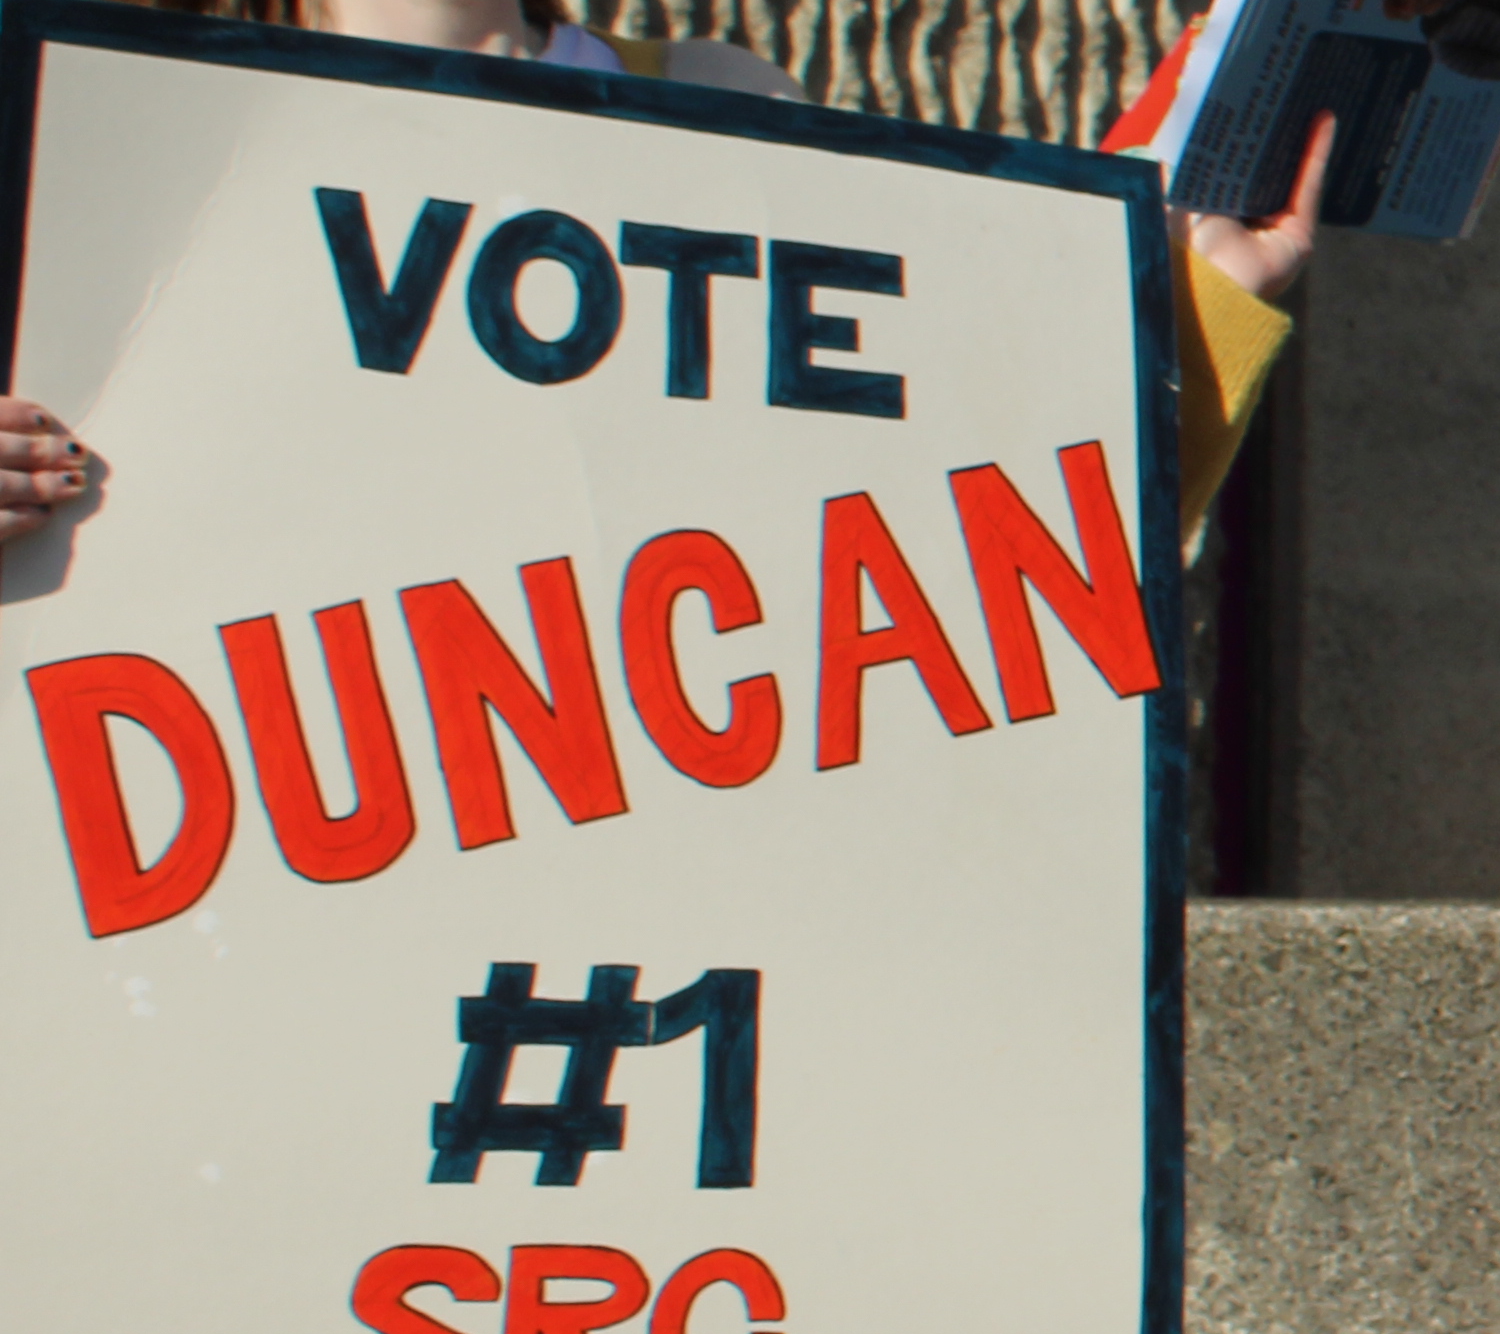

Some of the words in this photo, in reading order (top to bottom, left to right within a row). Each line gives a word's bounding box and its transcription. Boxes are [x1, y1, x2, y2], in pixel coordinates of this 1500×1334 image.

[317, 187, 906, 419] VOTE
[27, 442, 1162, 937] DUNCAN
[431, 963, 758, 1188] #1
